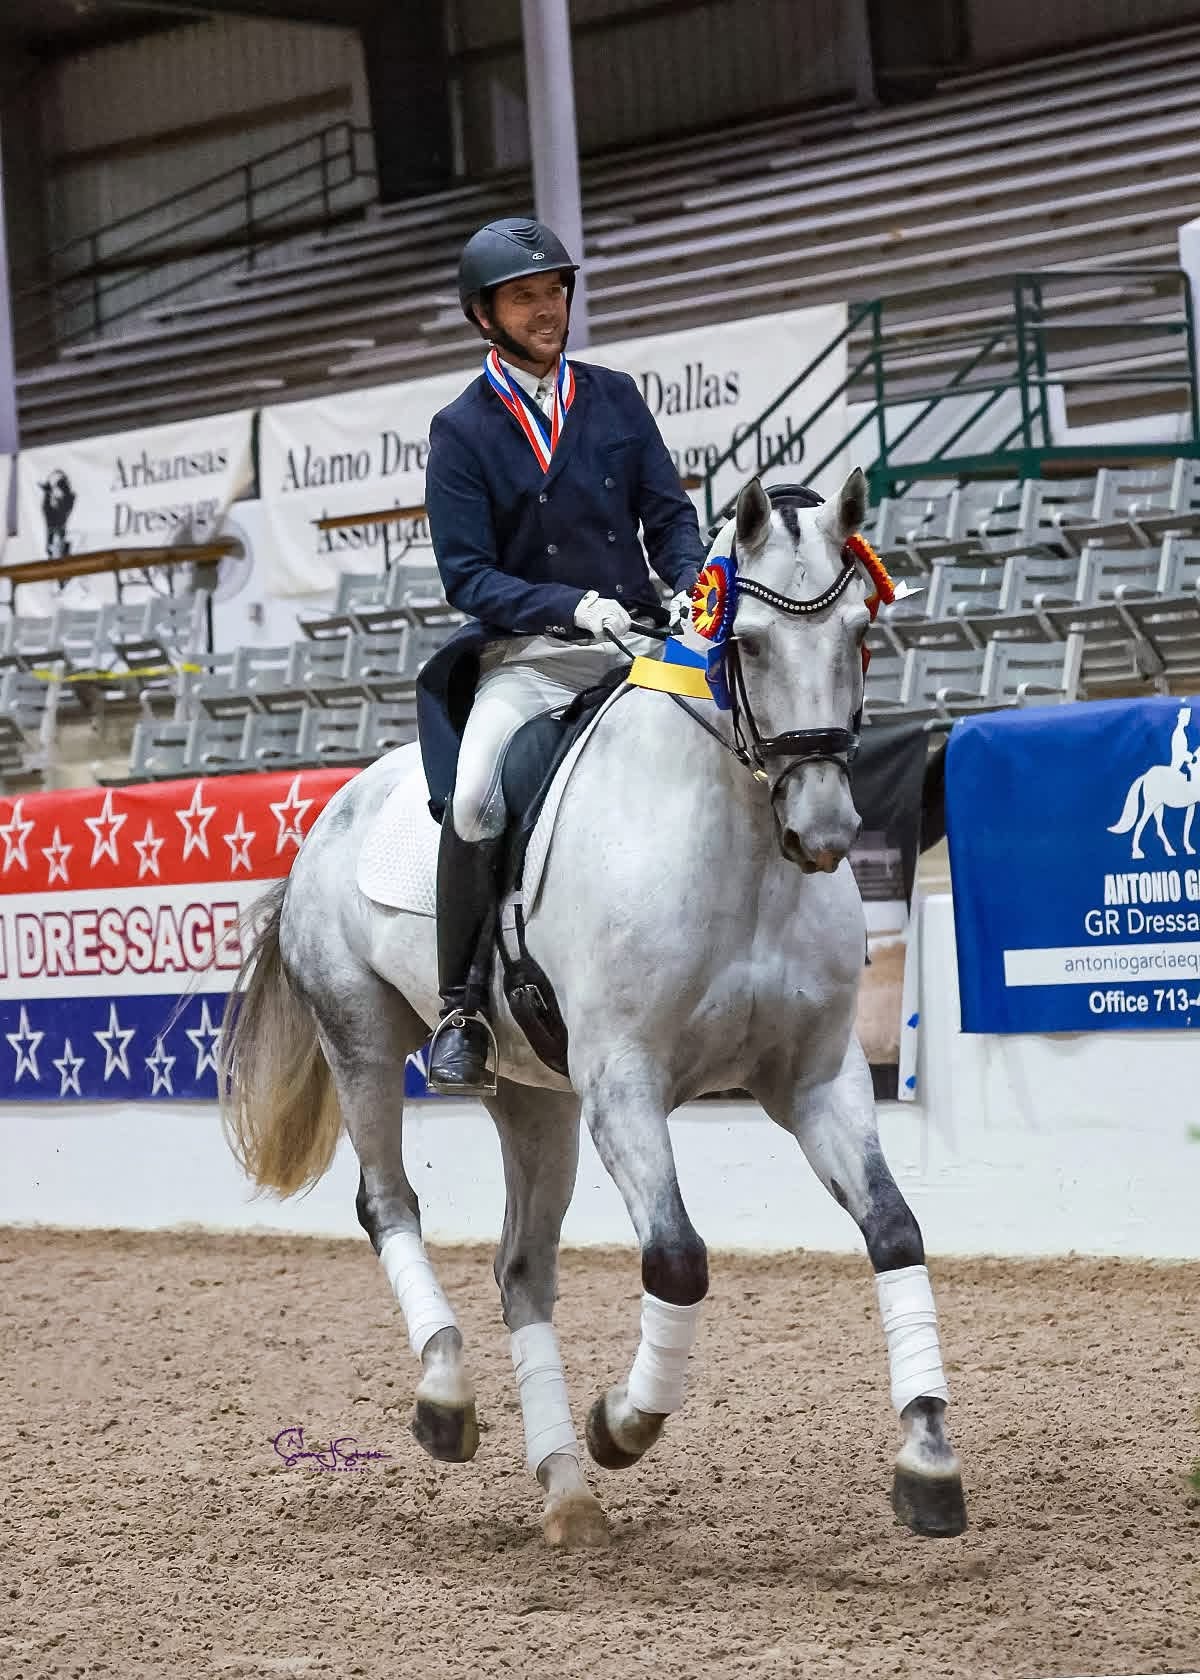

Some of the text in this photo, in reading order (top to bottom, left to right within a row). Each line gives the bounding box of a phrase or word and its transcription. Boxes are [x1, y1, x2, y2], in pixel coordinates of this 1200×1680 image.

[640, 362, 741, 417] Dallas
[731, 416, 805, 474] Club
[110, 448, 228, 492] Arkansas
[281, 443, 371, 493] Alamo
[114, 496, 220, 538] Dressage
[1103, 869, 1200, 906] ANTONIO G
[15, 902, 242, 978] DRESSAGE
[1084, 908, 1200, 937] GR Dressa
[1064, 950, 1200, 975] antoniogarciaeq
[1088, 990, 1149, 1014] Office
